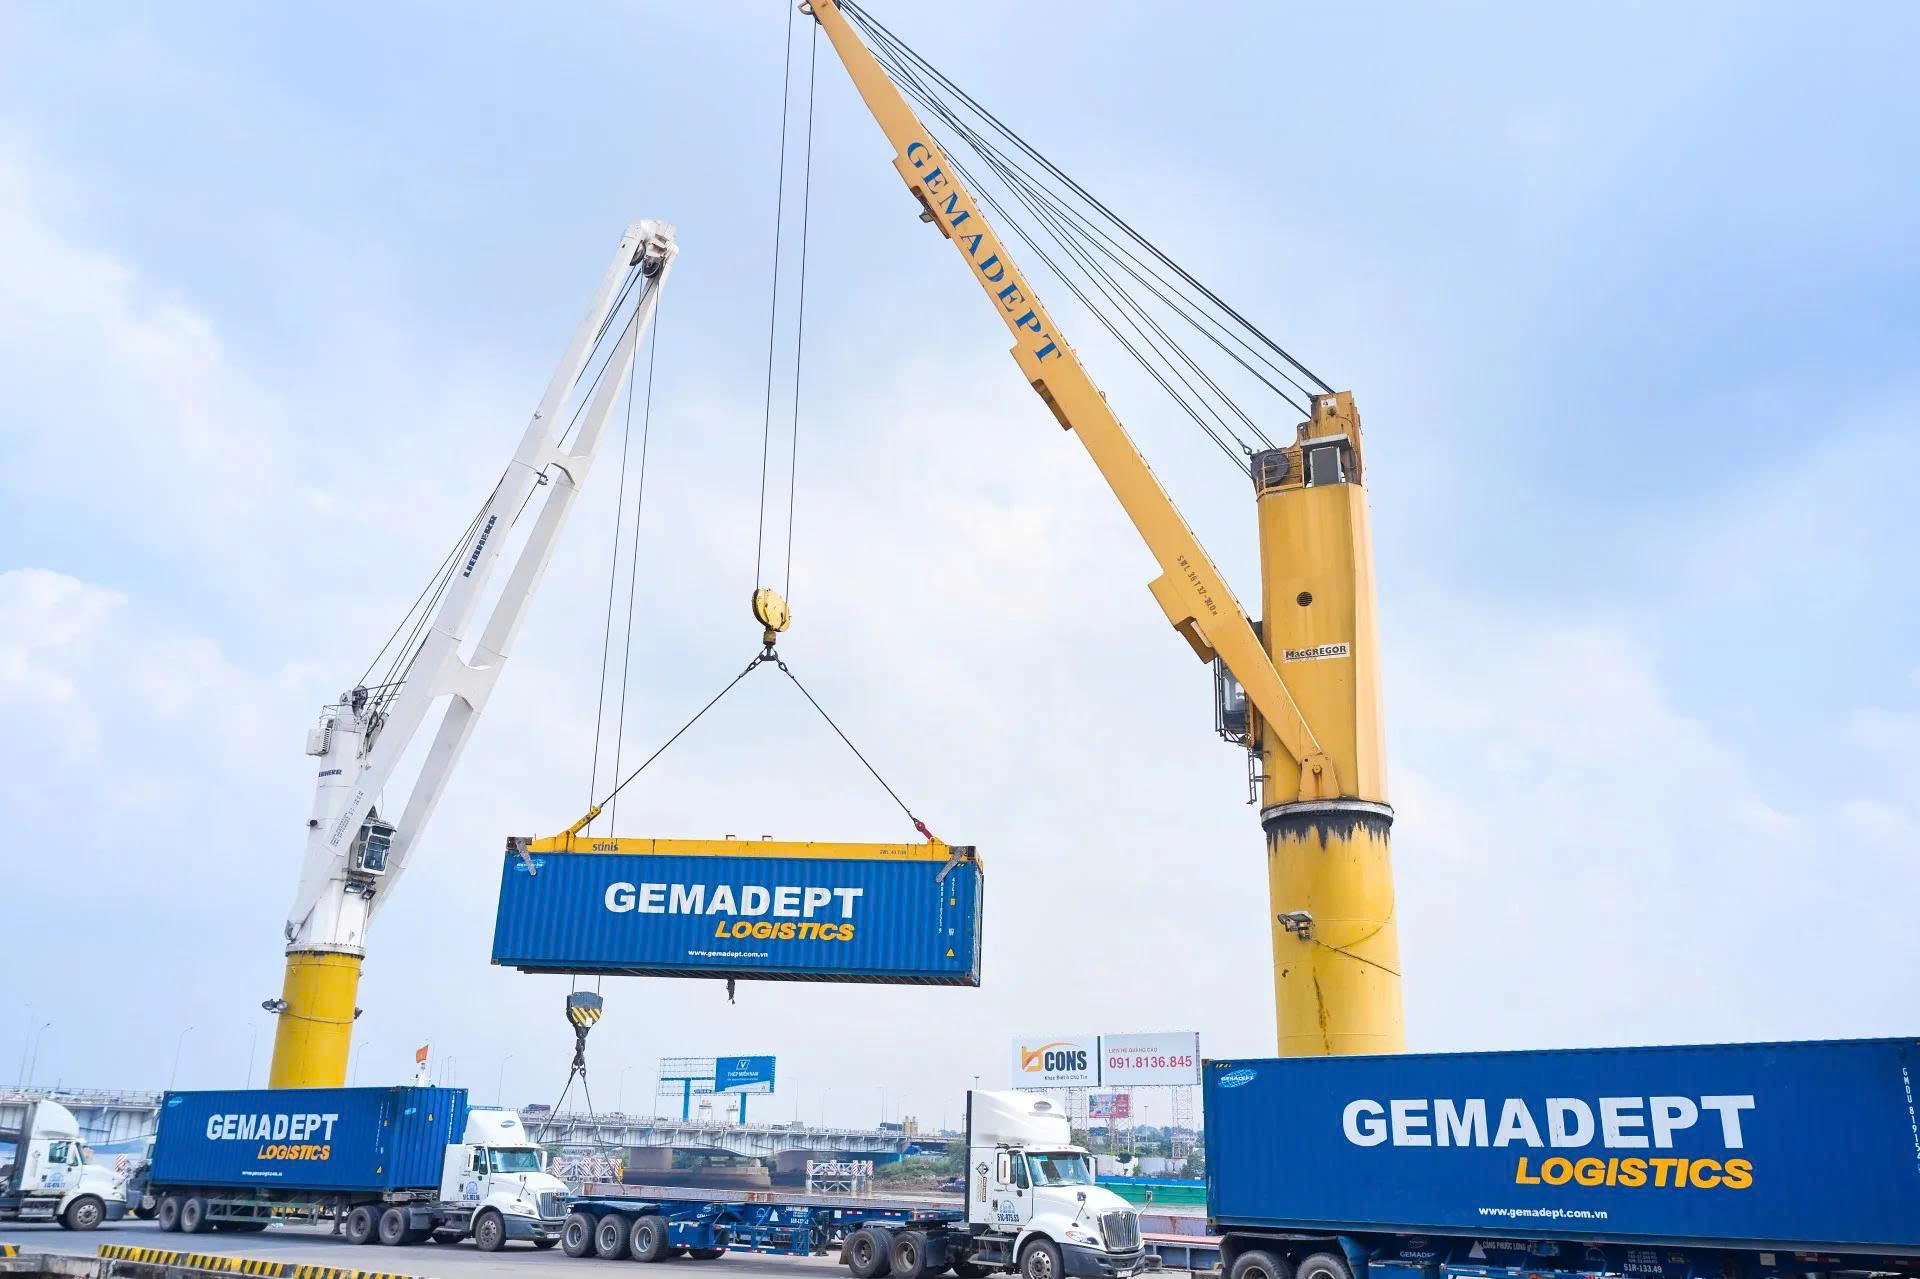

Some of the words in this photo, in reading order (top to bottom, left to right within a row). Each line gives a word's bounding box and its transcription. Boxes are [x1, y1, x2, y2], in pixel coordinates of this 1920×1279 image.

[907, 141, 1062, 364] GEMADEPT
[1285, 645, 1347, 658] MacGREGOR
[604, 881, 864, 919] GEMADEPT
[714, 920, 856, 942] LOGISTICS
[688, 949, 769, 959] www.gemadept.com.vn
[1109, 1055, 1193, 1069] 091.8136.845
[206, 1113, 339, 1141] GEMADEPT
[1342, 1094, 1756, 1149] GEMADEPT
[257, 1145, 331, 1160] LOGISTICS
[1515, 1156, 1754, 1189] LOGISTICS
[1478, 1206, 1608, 1220] www.gemadept.com.vn
